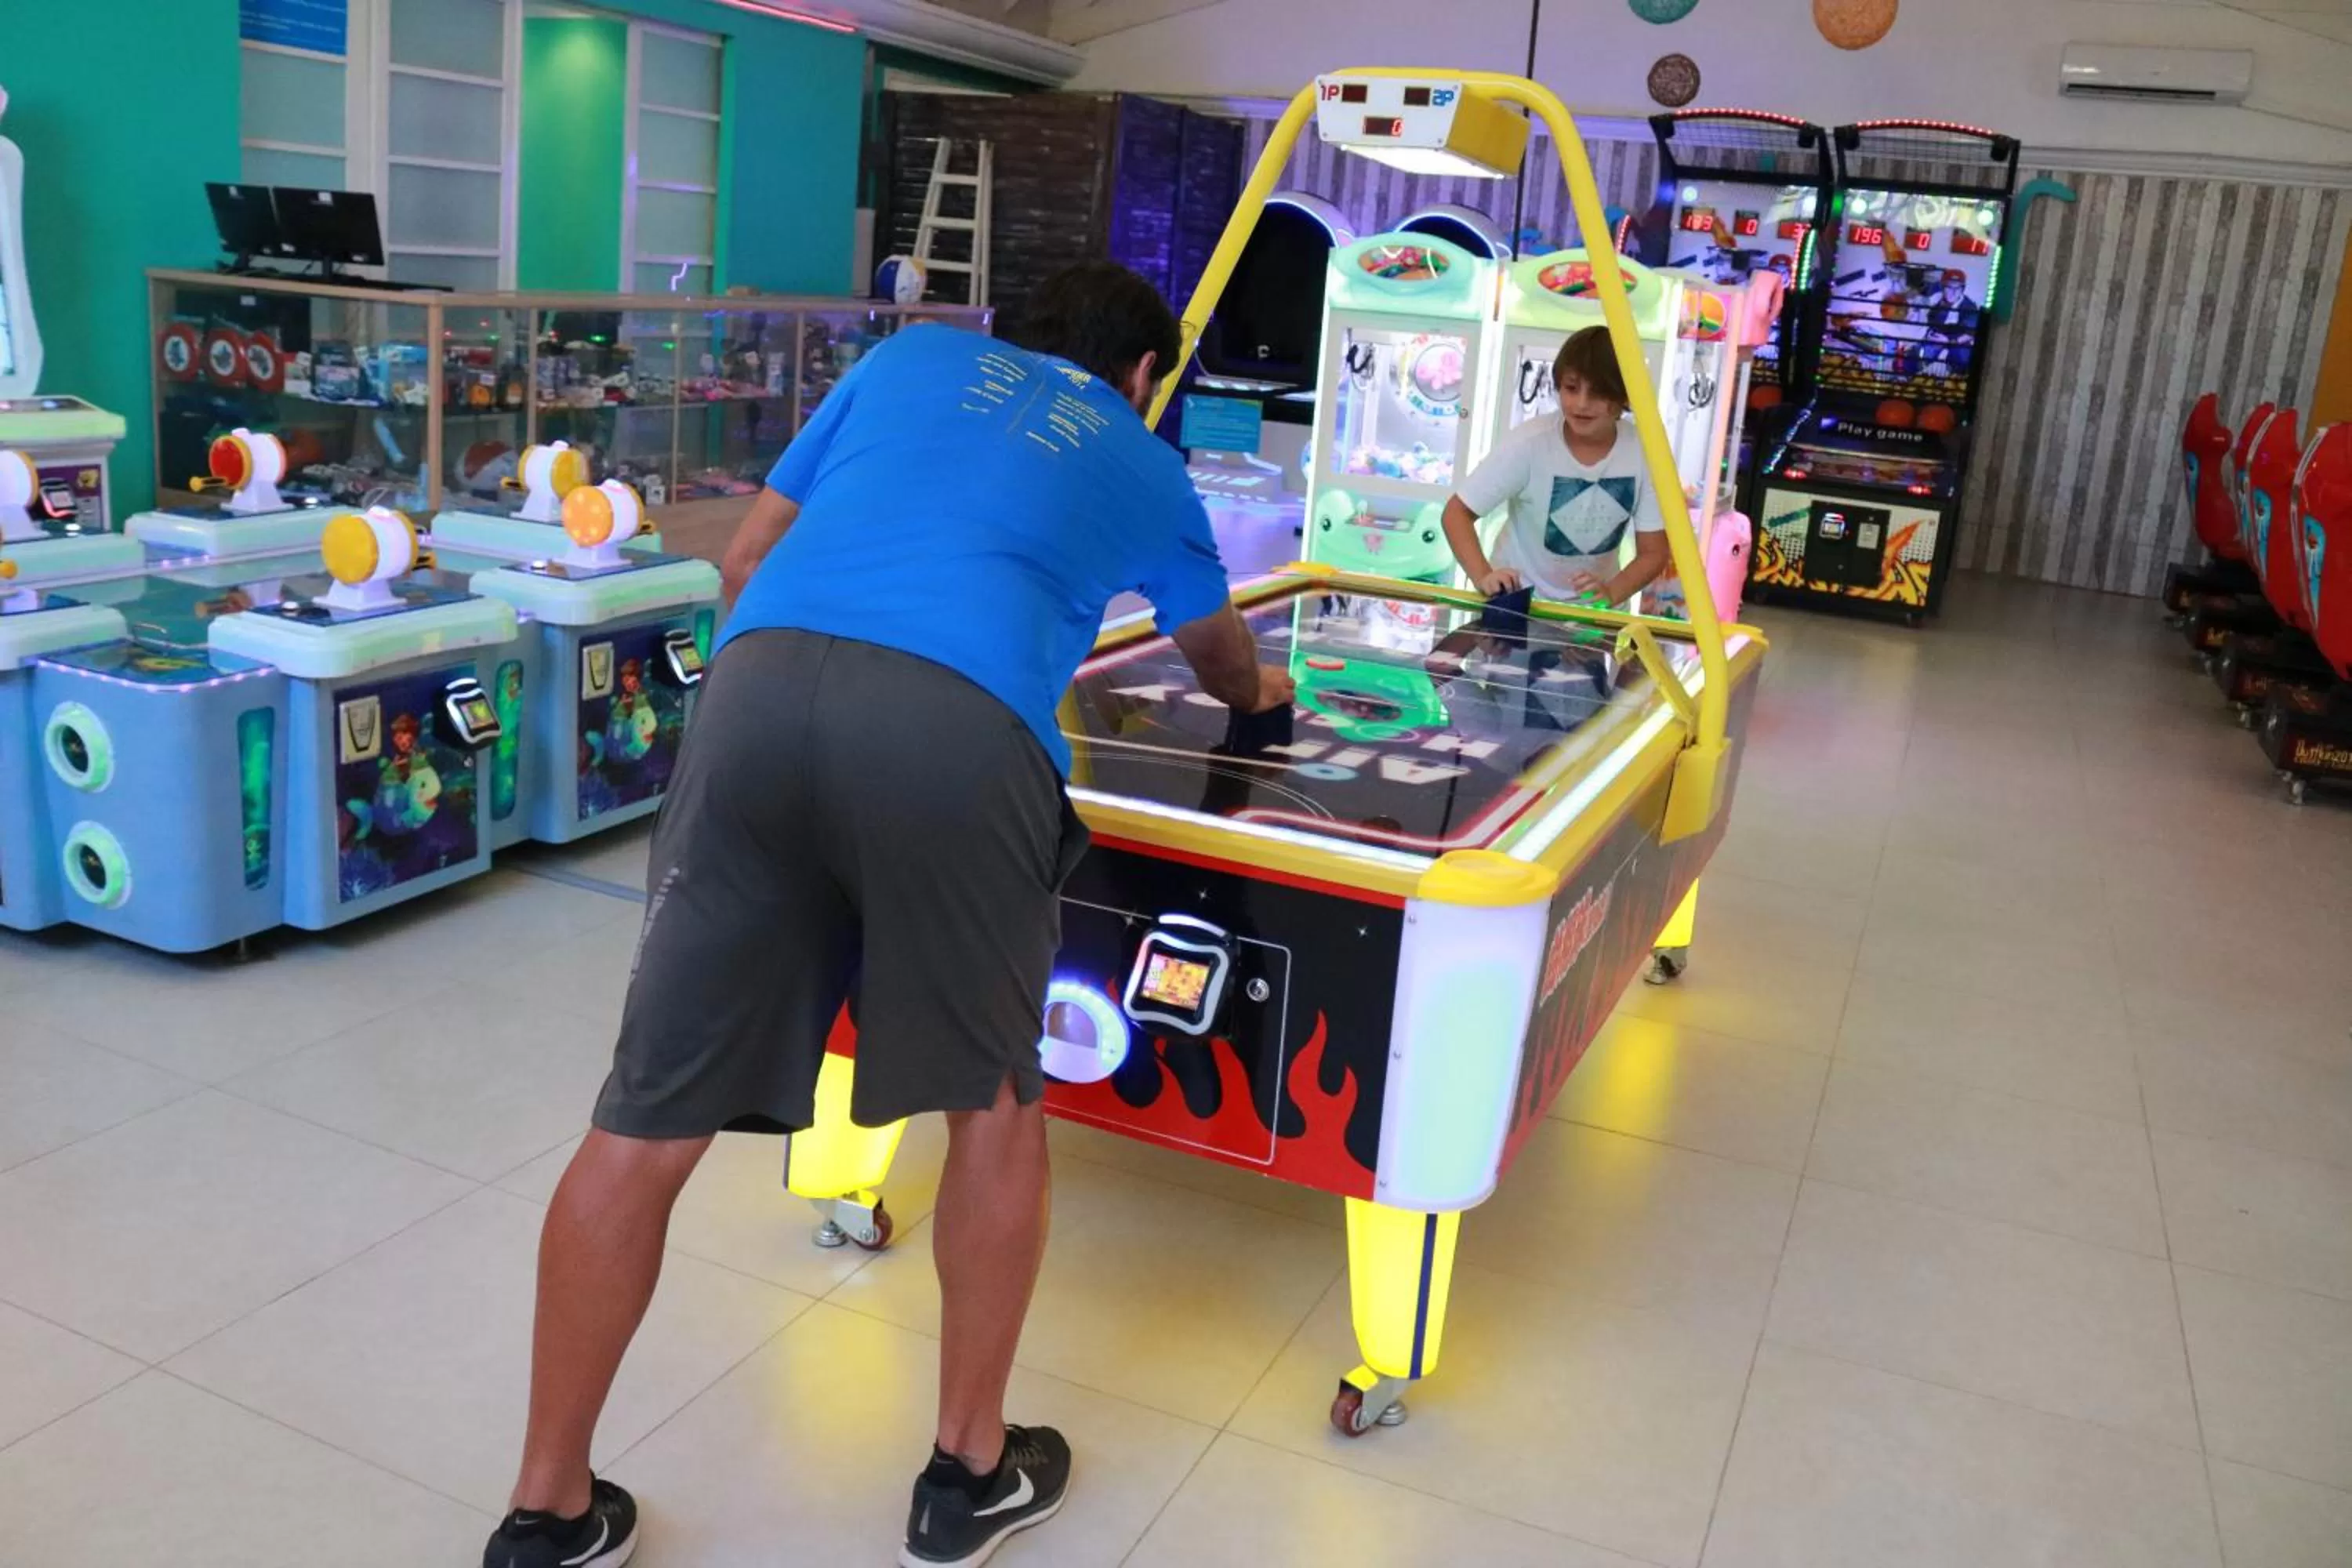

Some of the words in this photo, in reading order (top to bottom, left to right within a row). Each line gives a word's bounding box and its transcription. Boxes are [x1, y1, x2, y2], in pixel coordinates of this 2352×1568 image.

[1321, 85, 1339, 100] 1P
[1433, 89, 1454, 106] 2P
[1746, 219, 1758, 234] 0
[1853, 227, 1882, 244] 196
[1917, 233, 1931, 250] 0
[1838, 422, 1872, 437] Play
[1877, 430, 1922, 442] game
